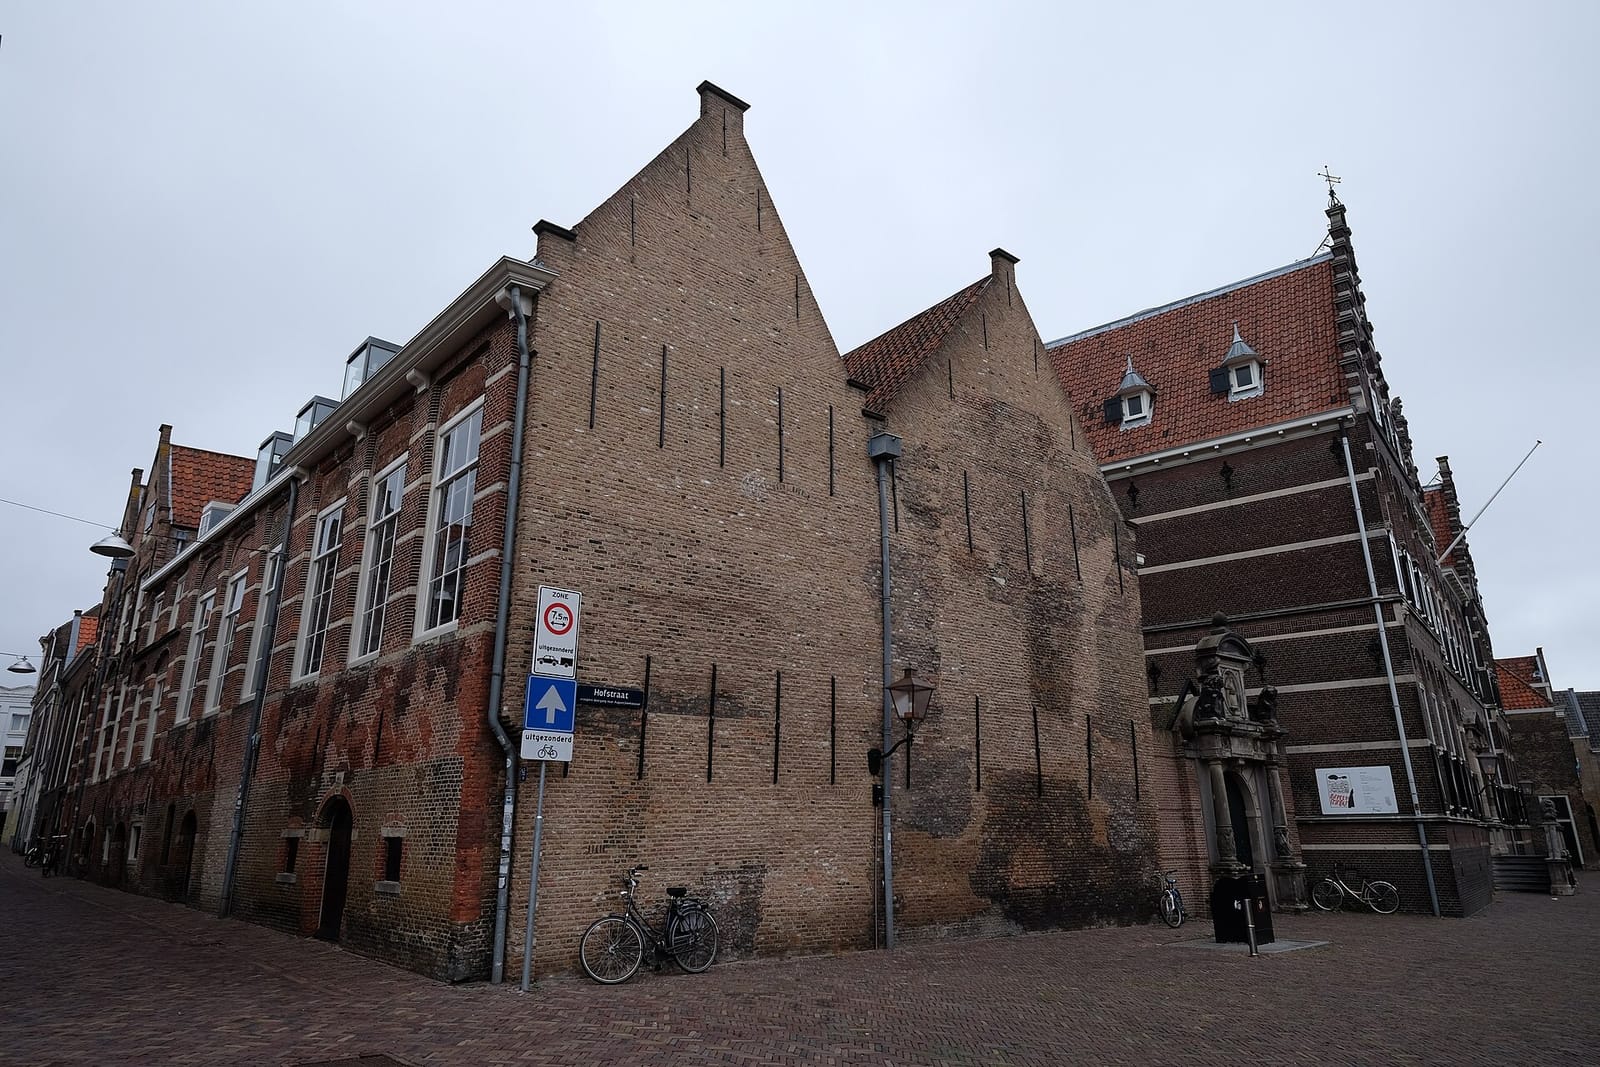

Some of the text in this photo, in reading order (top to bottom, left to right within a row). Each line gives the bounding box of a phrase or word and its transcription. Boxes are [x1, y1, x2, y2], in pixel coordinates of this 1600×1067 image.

[552, 592, 569, 600] ZONE
[539, 644, 574, 654] uitgezonderd
[593, 688, 629, 700] Hofstraat
[525, 733, 572, 743] uitgezonderd
